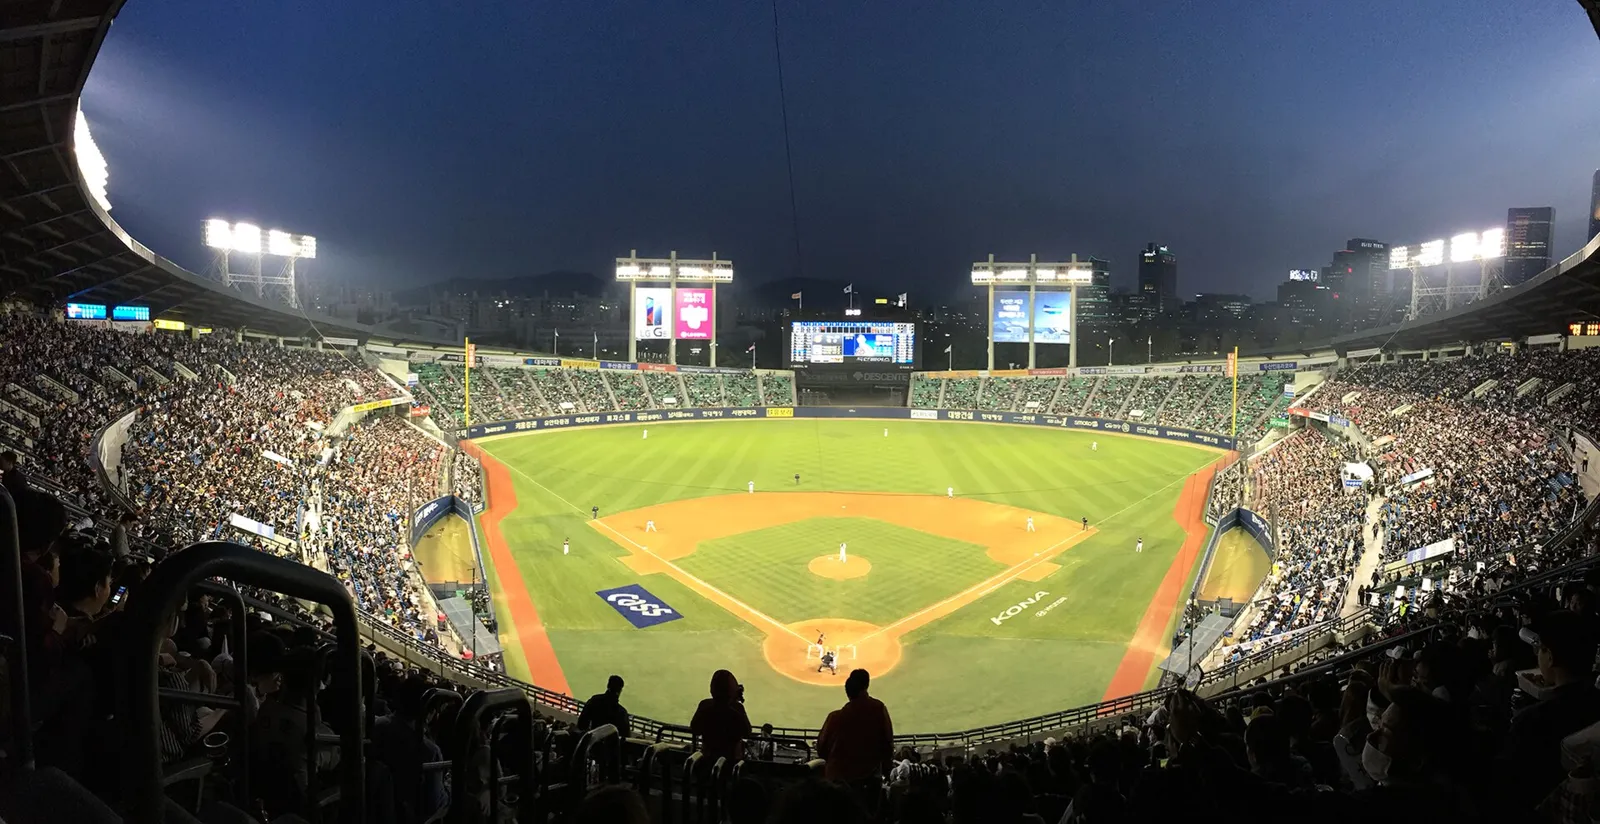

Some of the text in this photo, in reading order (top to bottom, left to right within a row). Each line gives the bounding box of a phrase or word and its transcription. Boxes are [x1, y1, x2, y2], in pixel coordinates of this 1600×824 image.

[1263, 362, 1294, 370] 두산인프라코어
[864, 371, 909, 381] DESCENTE
[947, 410, 974, 420] 대방건설
[990, 591, 1050, 626] KONA
